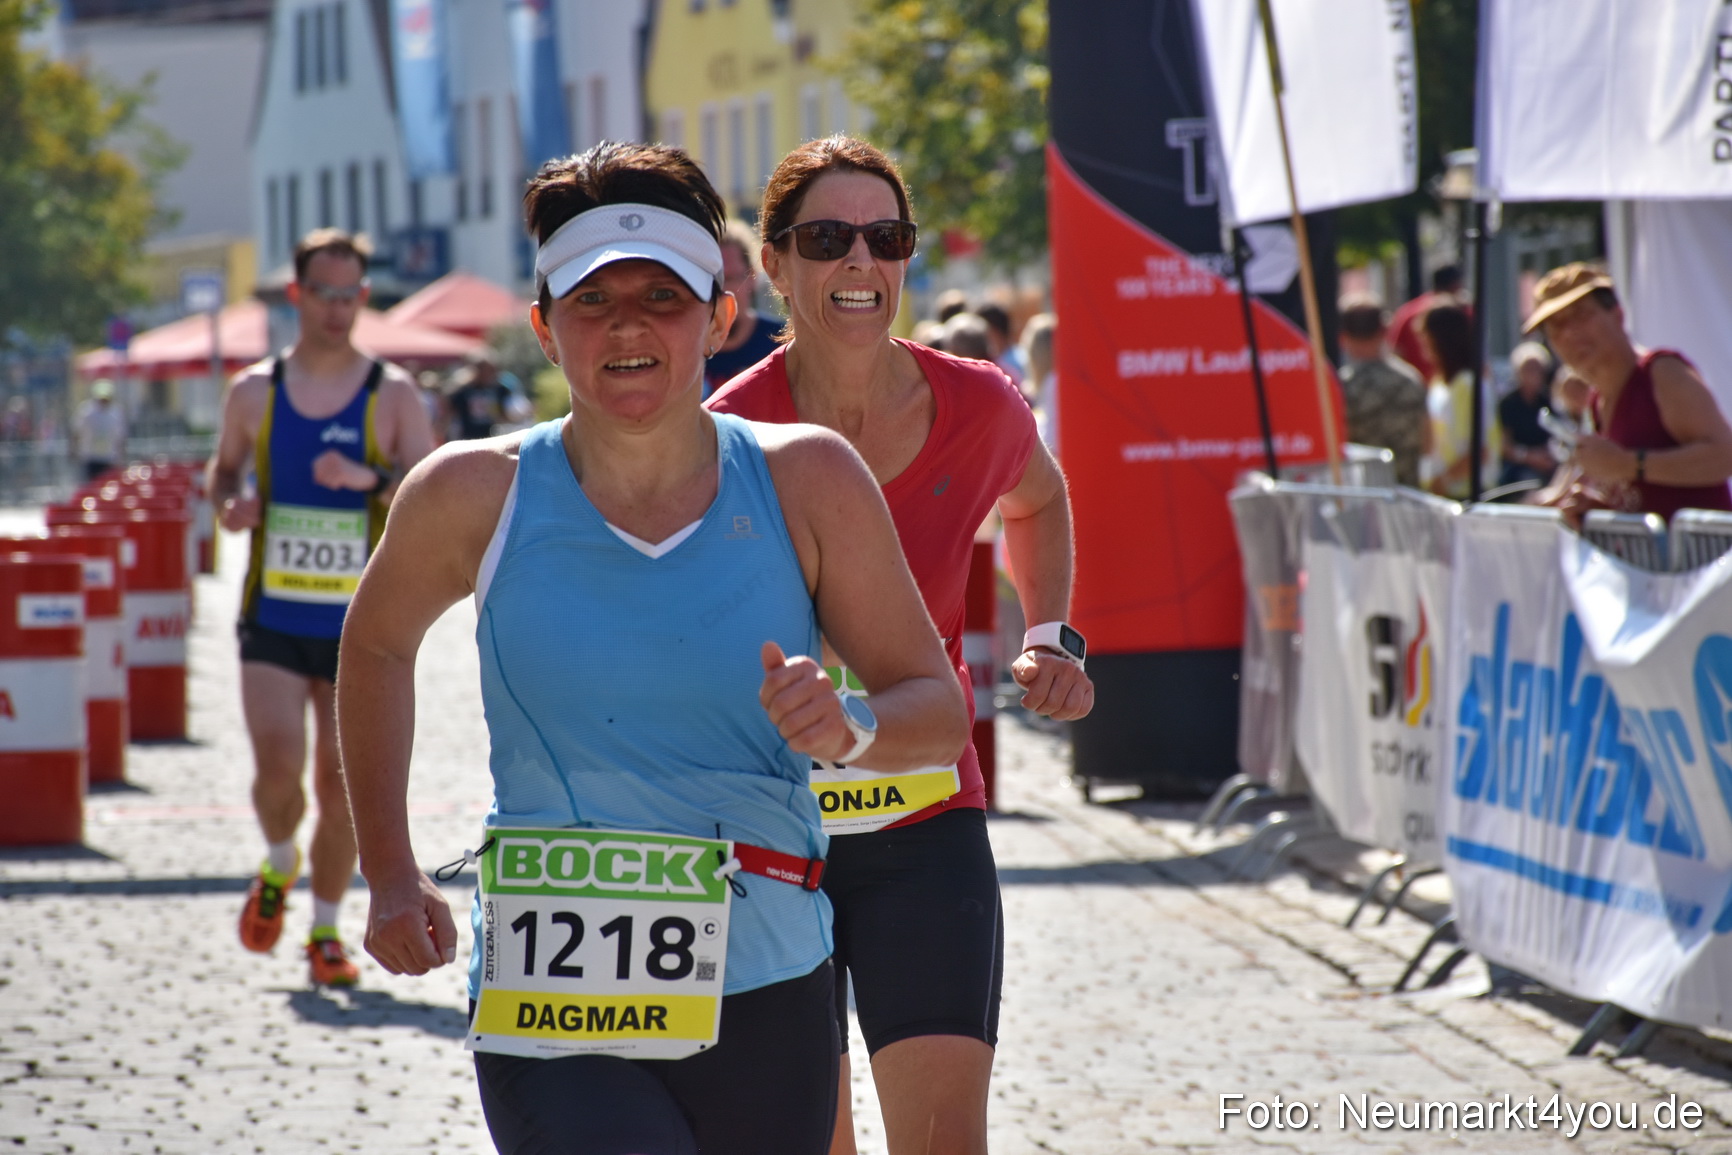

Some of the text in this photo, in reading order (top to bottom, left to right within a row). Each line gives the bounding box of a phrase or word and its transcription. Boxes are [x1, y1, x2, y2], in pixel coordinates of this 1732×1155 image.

[1118, 350, 1188, 378] BMW
[279, 541, 353, 572] 1203
[497, 837, 707, 895] BOCK
[766, 866, 780, 878] new
[510, 910, 696, 981] 1218
[516, 1002, 668, 1033] DAGMAR
